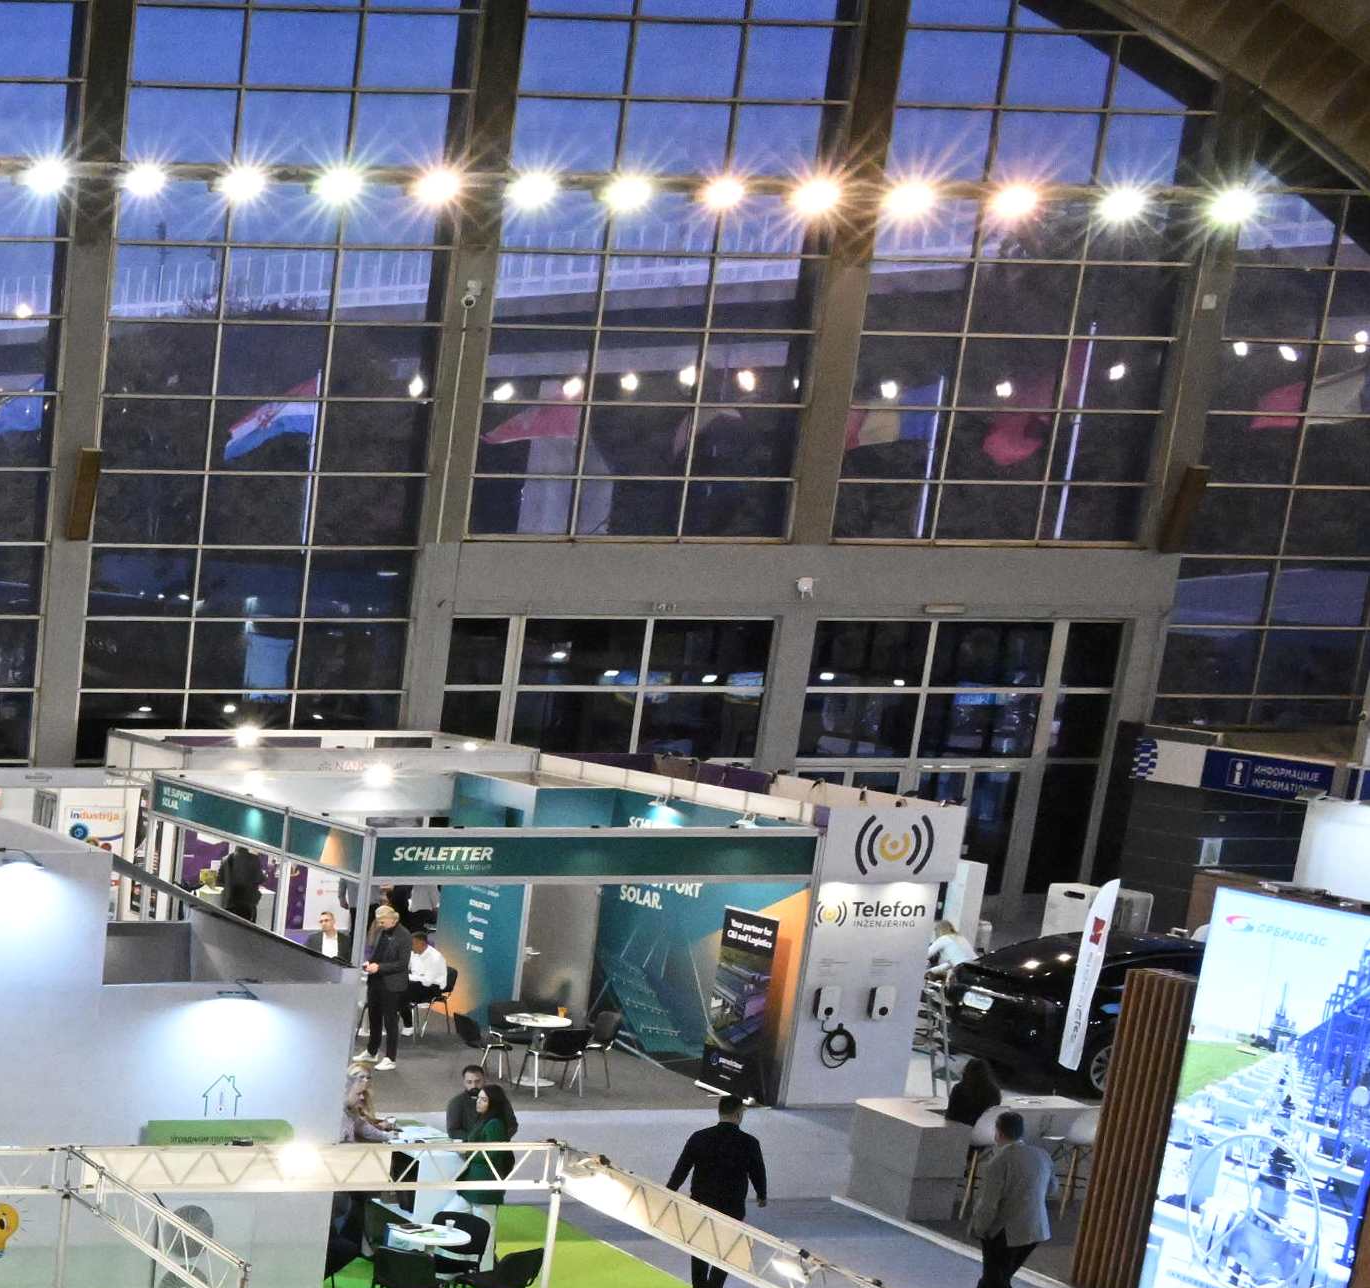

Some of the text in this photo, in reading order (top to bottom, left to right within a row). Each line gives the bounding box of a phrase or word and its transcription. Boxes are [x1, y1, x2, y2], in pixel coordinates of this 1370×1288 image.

[70, 810, 120, 822] industrija
[392, 846, 494, 862] SCHLETTER
[620, 884, 662, 910] SOLAR.
[853, 901, 926, 918] Telefon
